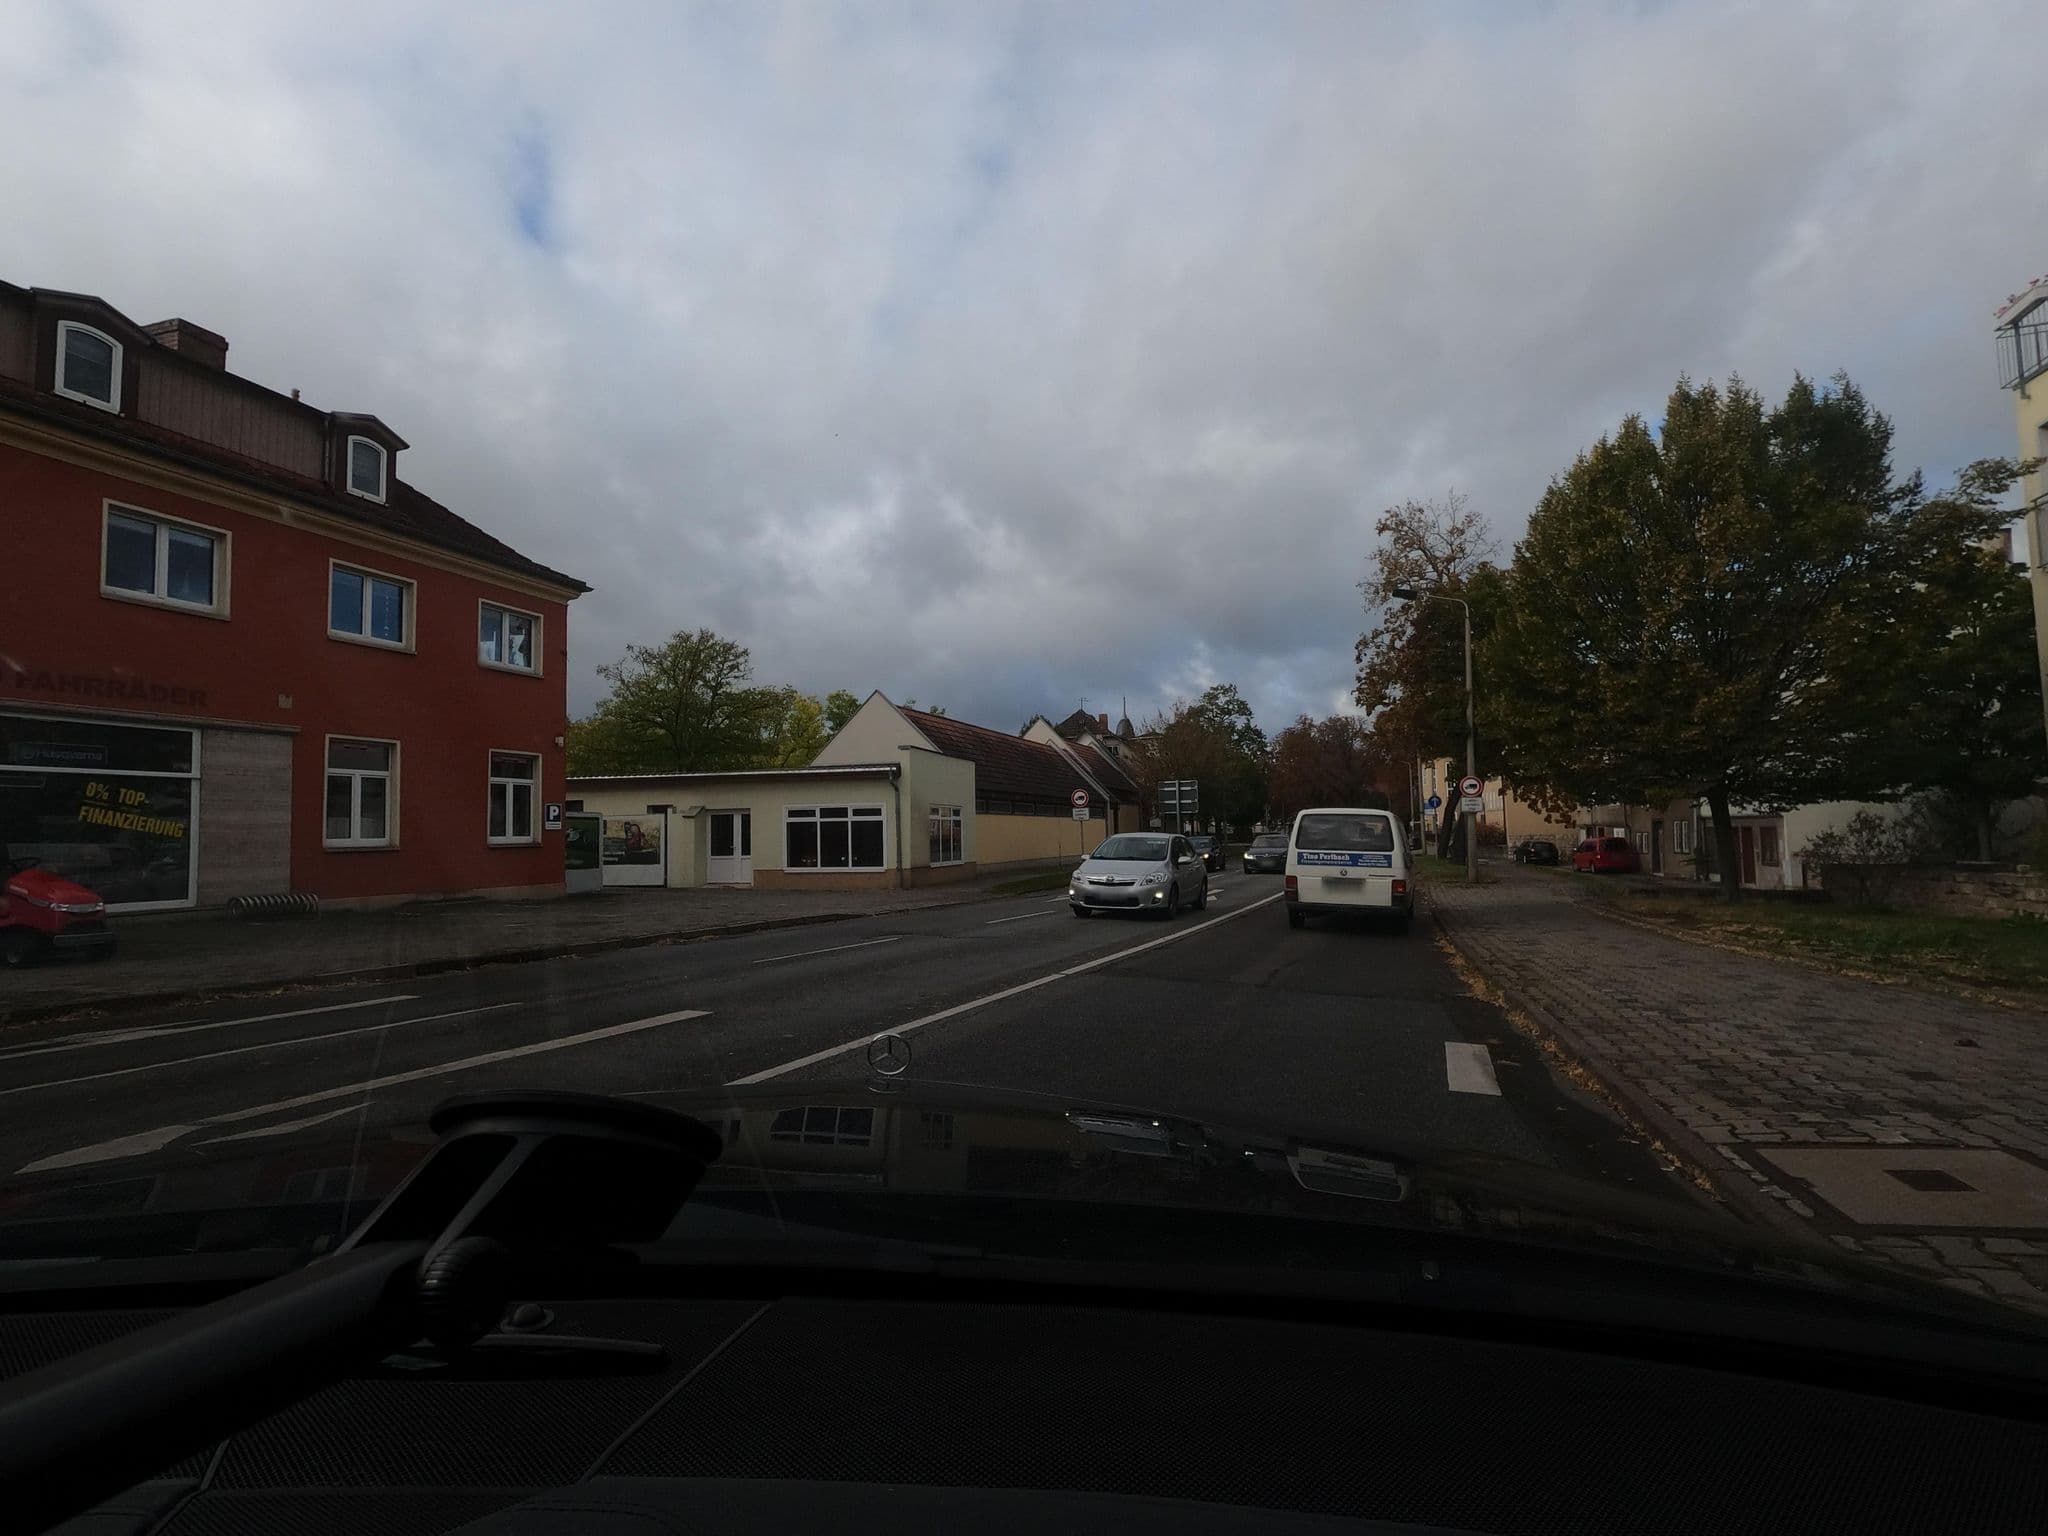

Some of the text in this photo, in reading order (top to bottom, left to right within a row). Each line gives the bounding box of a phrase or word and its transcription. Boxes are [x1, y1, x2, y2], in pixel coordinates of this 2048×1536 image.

[16, 671, 208, 706] FAHRRÄDER
[86, 782, 110, 801] 0%
[79, 806, 185, 838] FINANZIERUNG
[549, 806, 559, 820] P
